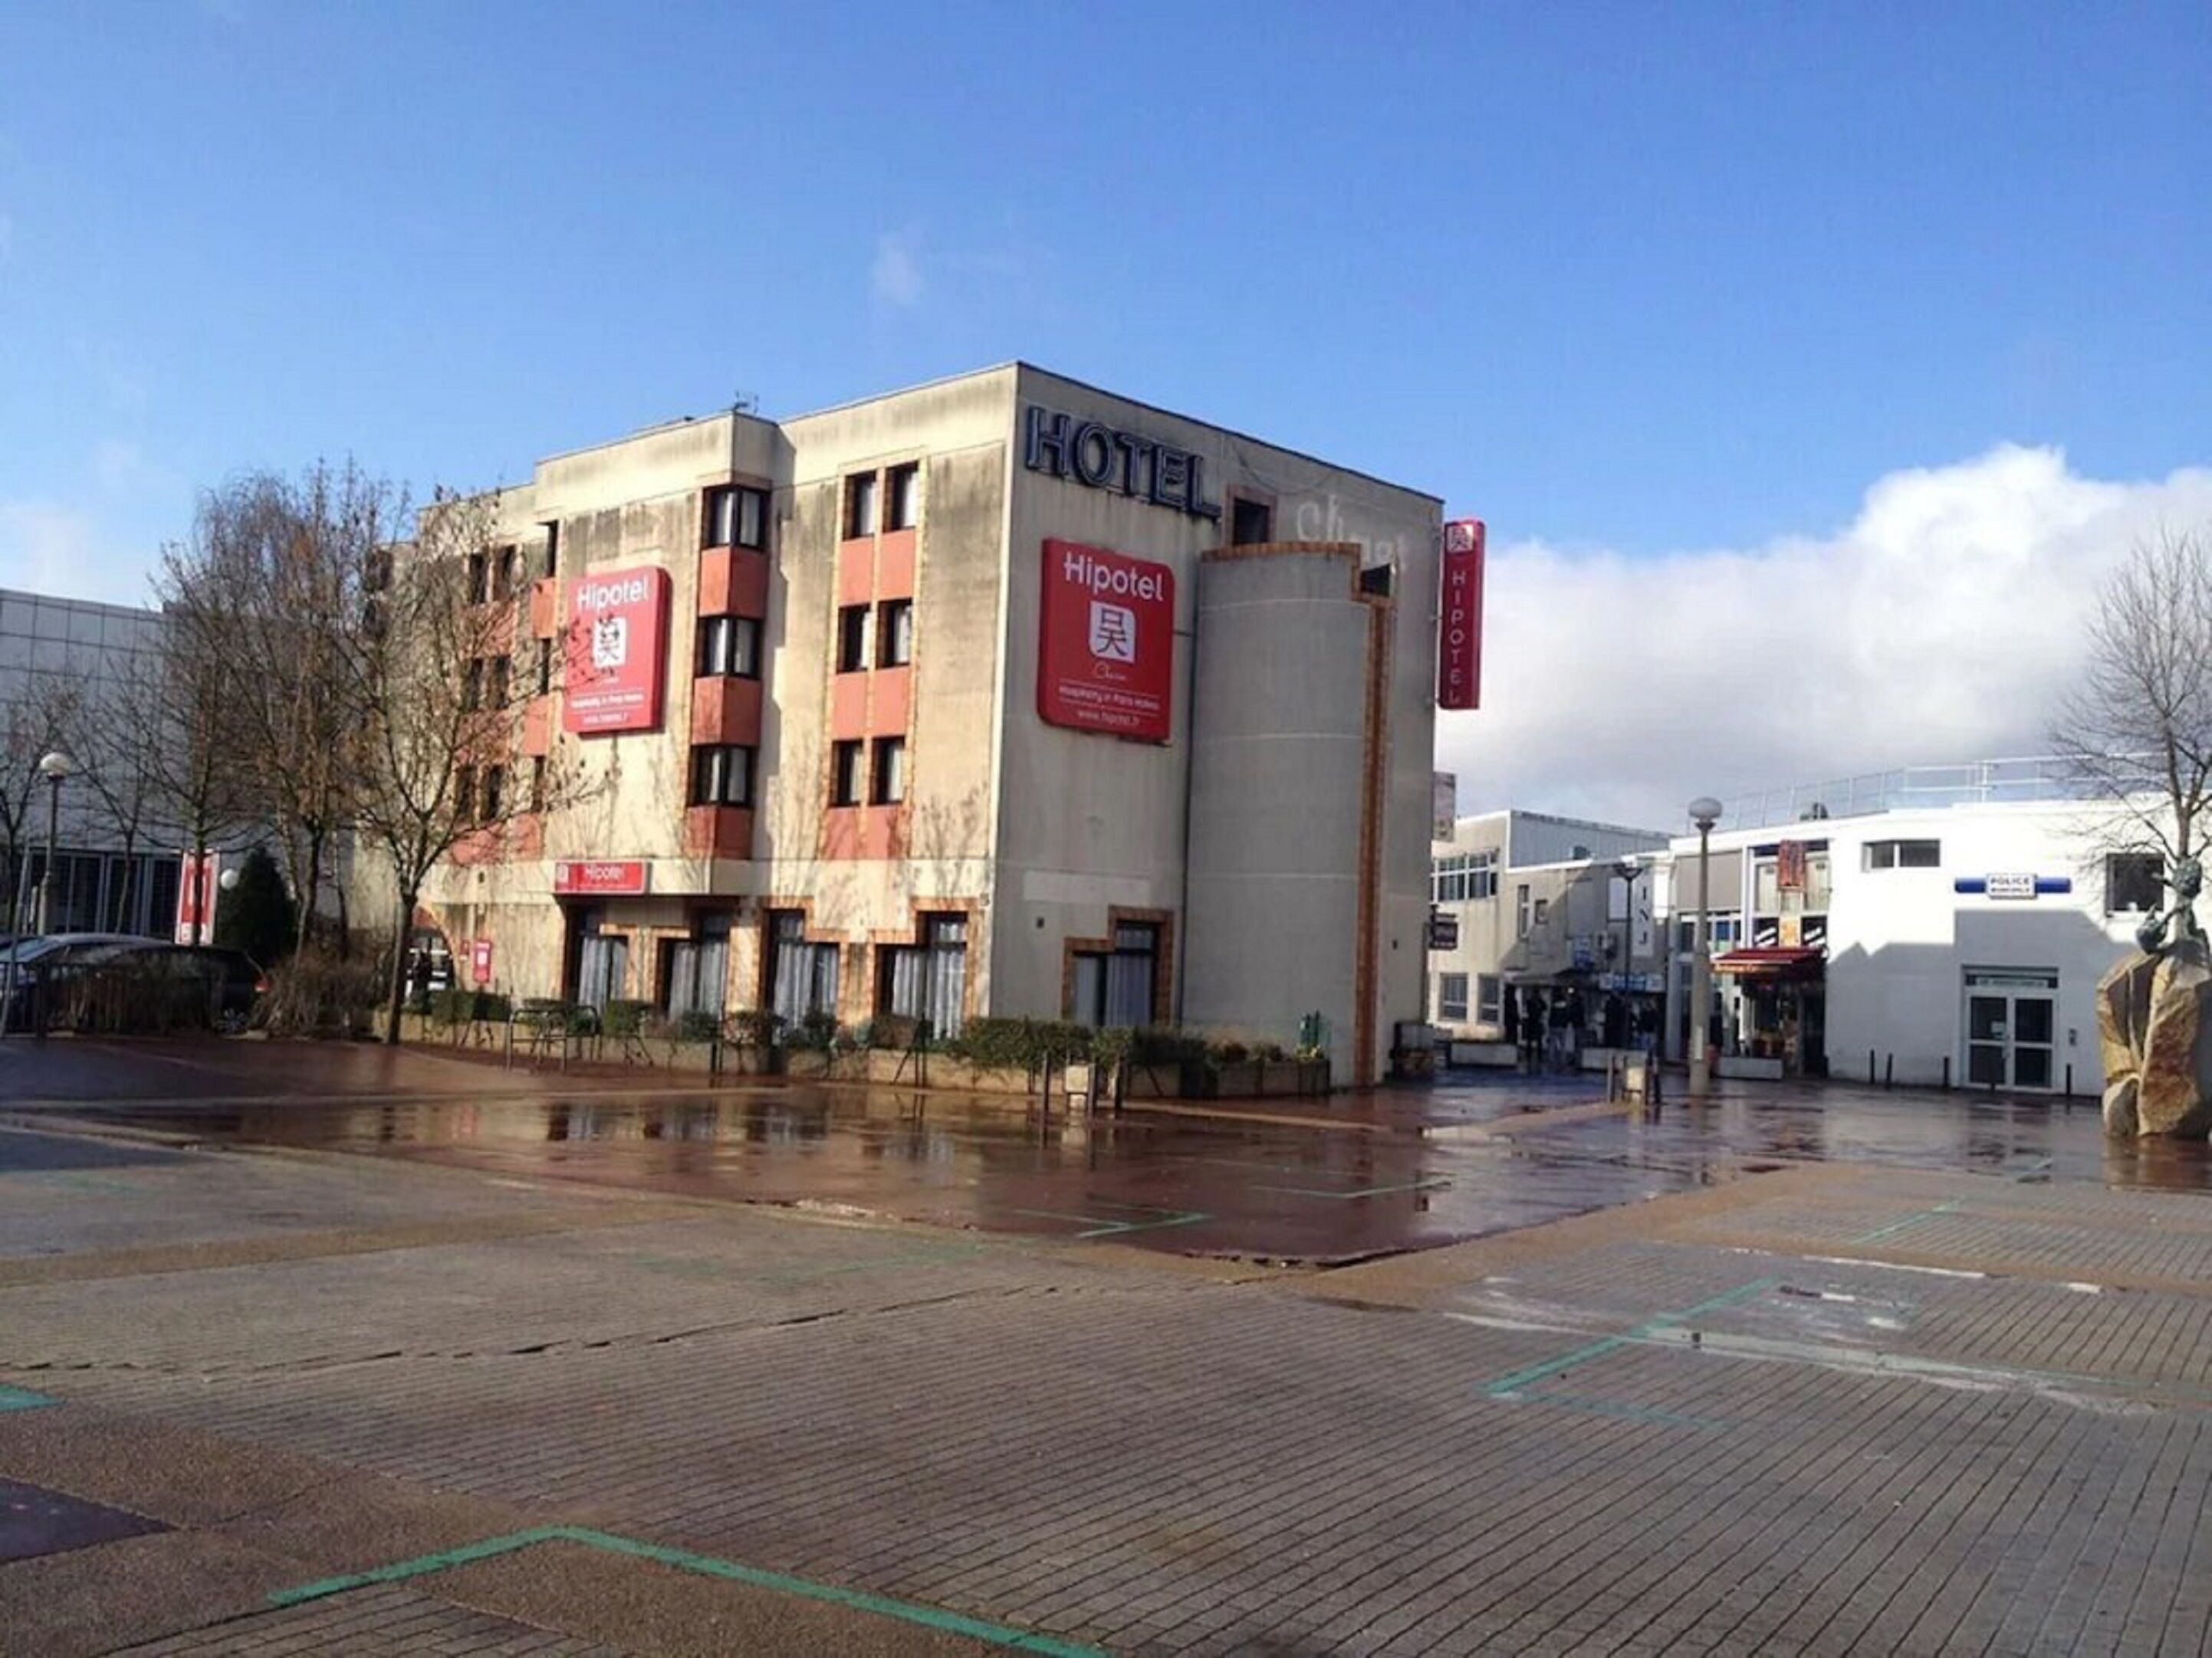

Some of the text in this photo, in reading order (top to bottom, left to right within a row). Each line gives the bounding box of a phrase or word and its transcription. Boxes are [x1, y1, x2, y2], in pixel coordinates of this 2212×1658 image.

[1026, 406, 1221, 518] HOTEL
[577, 577, 649, 612] Hipotel
[1063, 551, 1164, 602] Hipotel
[1449, 570, 1466, 704] HIPOTEL
[1990, 877, 2030, 885] POLICE
